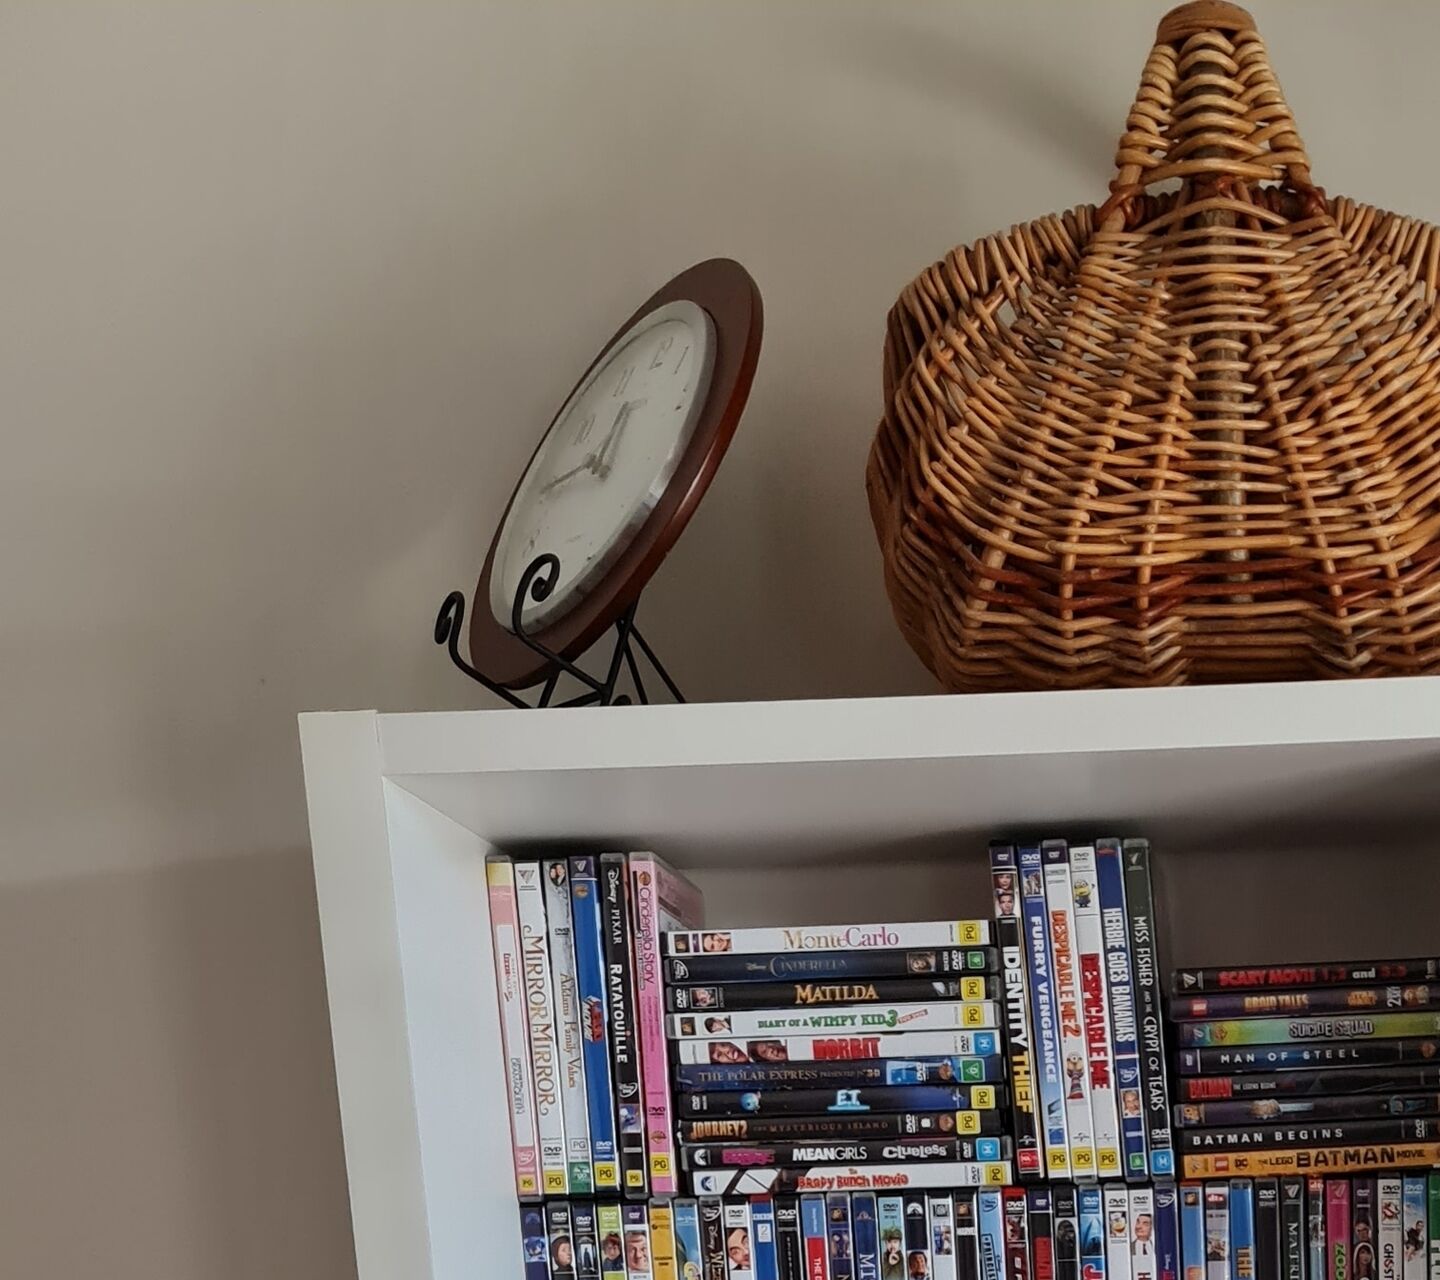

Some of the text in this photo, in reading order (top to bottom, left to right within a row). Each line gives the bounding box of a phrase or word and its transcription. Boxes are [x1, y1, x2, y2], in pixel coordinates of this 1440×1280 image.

[1134, 917, 1153, 986] MISS FISHER
[1103, 908, 1135, 1042] HERBIE GOES BANANAS
[795, 984, 880, 1005] MATILDA
[1031, 915, 1058, 1083] FURRY VENGEANCE
[609, 963, 629, 1064] RATATOUILLE
[810, 1014, 857, 1028] WIMPY
[1003, 946, 1033, 1114] IDENTITY THIEF
[1143, 1017, 1164, 1111] CRYPT TEARS
[1220, 1049, 1360, 1064] MAN OF STEEL
[699, 1068, 819, 1083] THE POLAR EXPRESS
[1193, 1128, 1344, 1145] BATMAN BEGINS
[1077, 1153, 1090, 1163] PG
[1296, 1147, 1396, 1168] BATMAN
[549, 1175, 562, 1186] PG
[599, 1168, 612, 1178] PG
